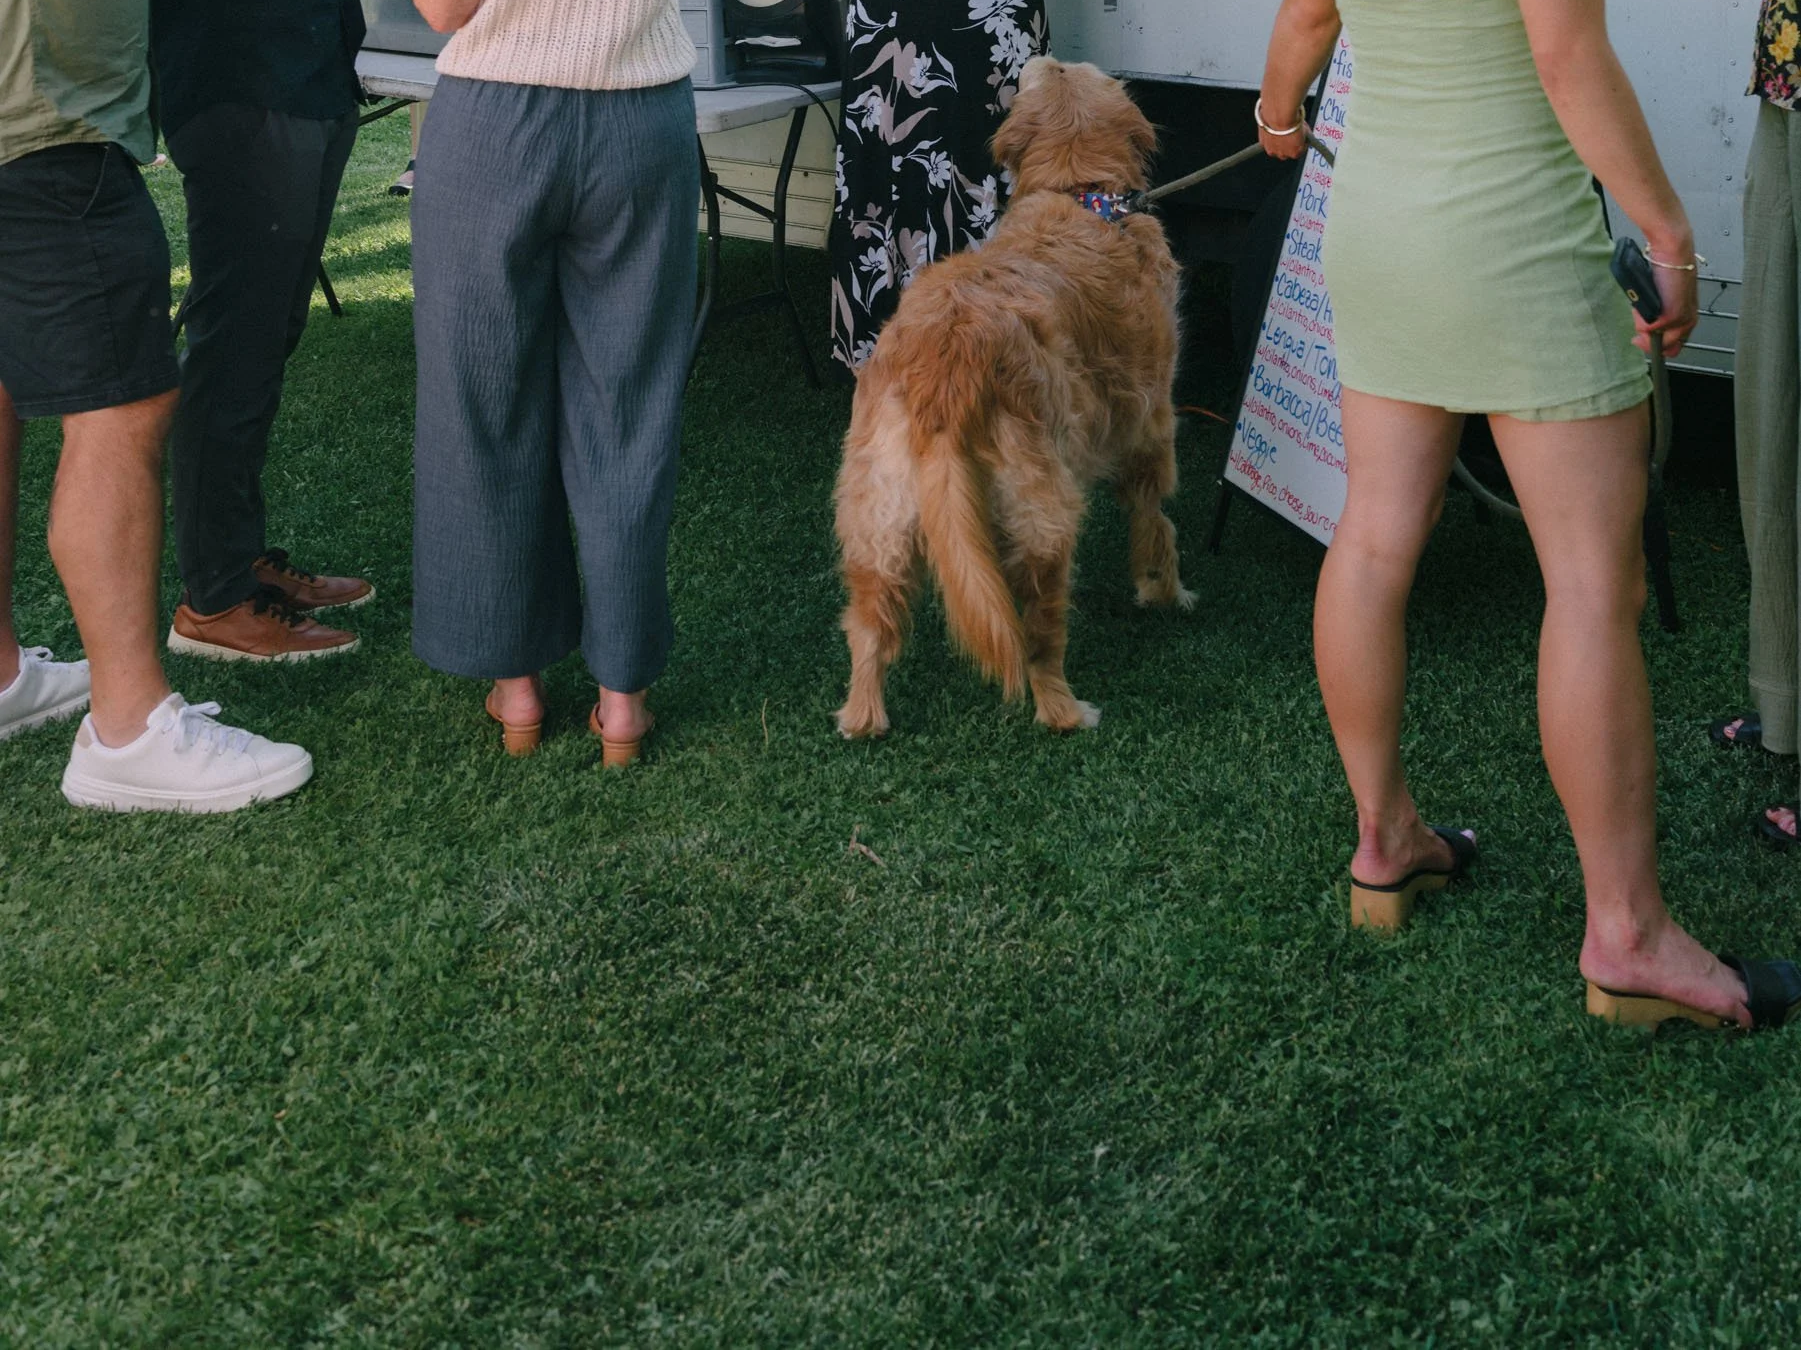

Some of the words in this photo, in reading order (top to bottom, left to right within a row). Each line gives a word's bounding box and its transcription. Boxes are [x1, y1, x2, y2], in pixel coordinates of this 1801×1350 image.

[1299, 183, 1328, 219] Pork
[1288, 228, 1323, 265] Steak
[1240, 417, 1278, 470] Veggie
